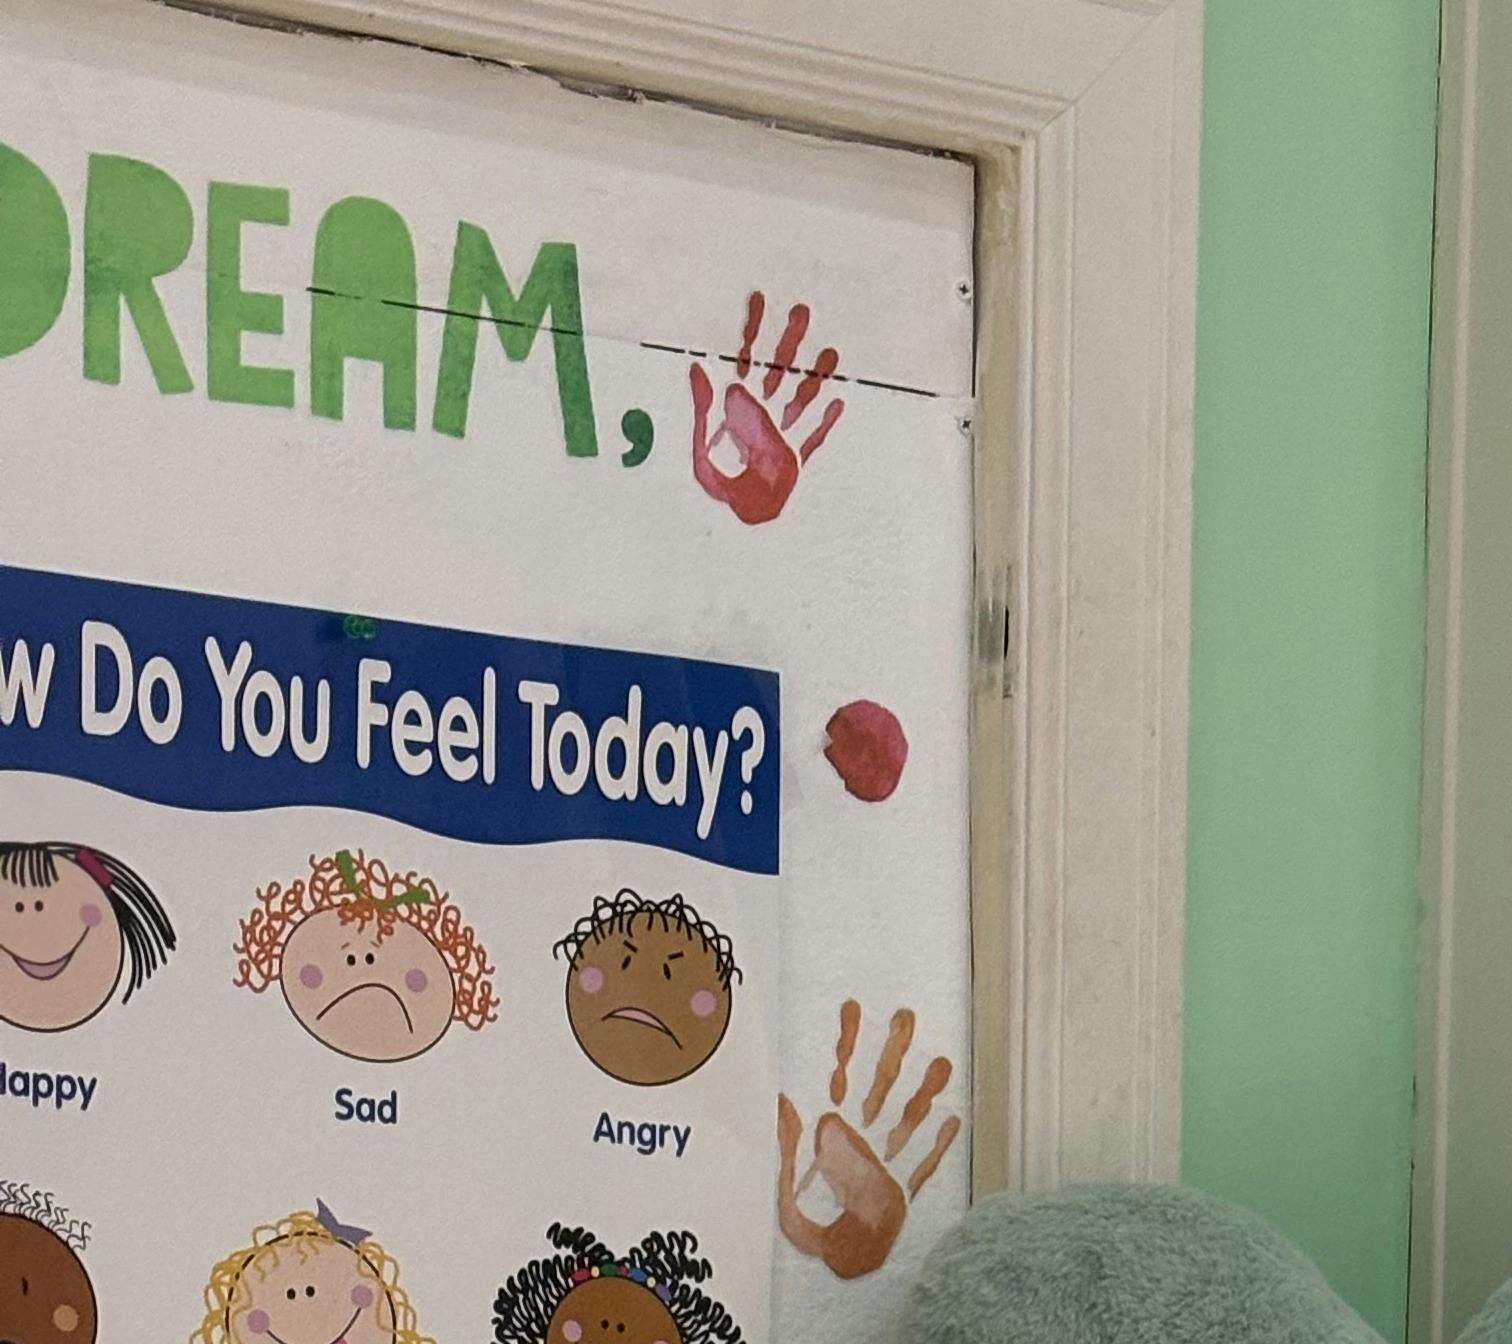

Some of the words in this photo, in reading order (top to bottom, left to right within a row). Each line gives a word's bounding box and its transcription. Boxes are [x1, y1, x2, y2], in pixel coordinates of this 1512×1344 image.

[81, 620, 183, 745] Do
[204, 636, 331, 763] You
[356, 658, 496, 784] Feel
[518, 681, 765, 839] Today?
[335, 1088, 397, 1124] Sad
[593, 1112, 691, 1157] Angry
